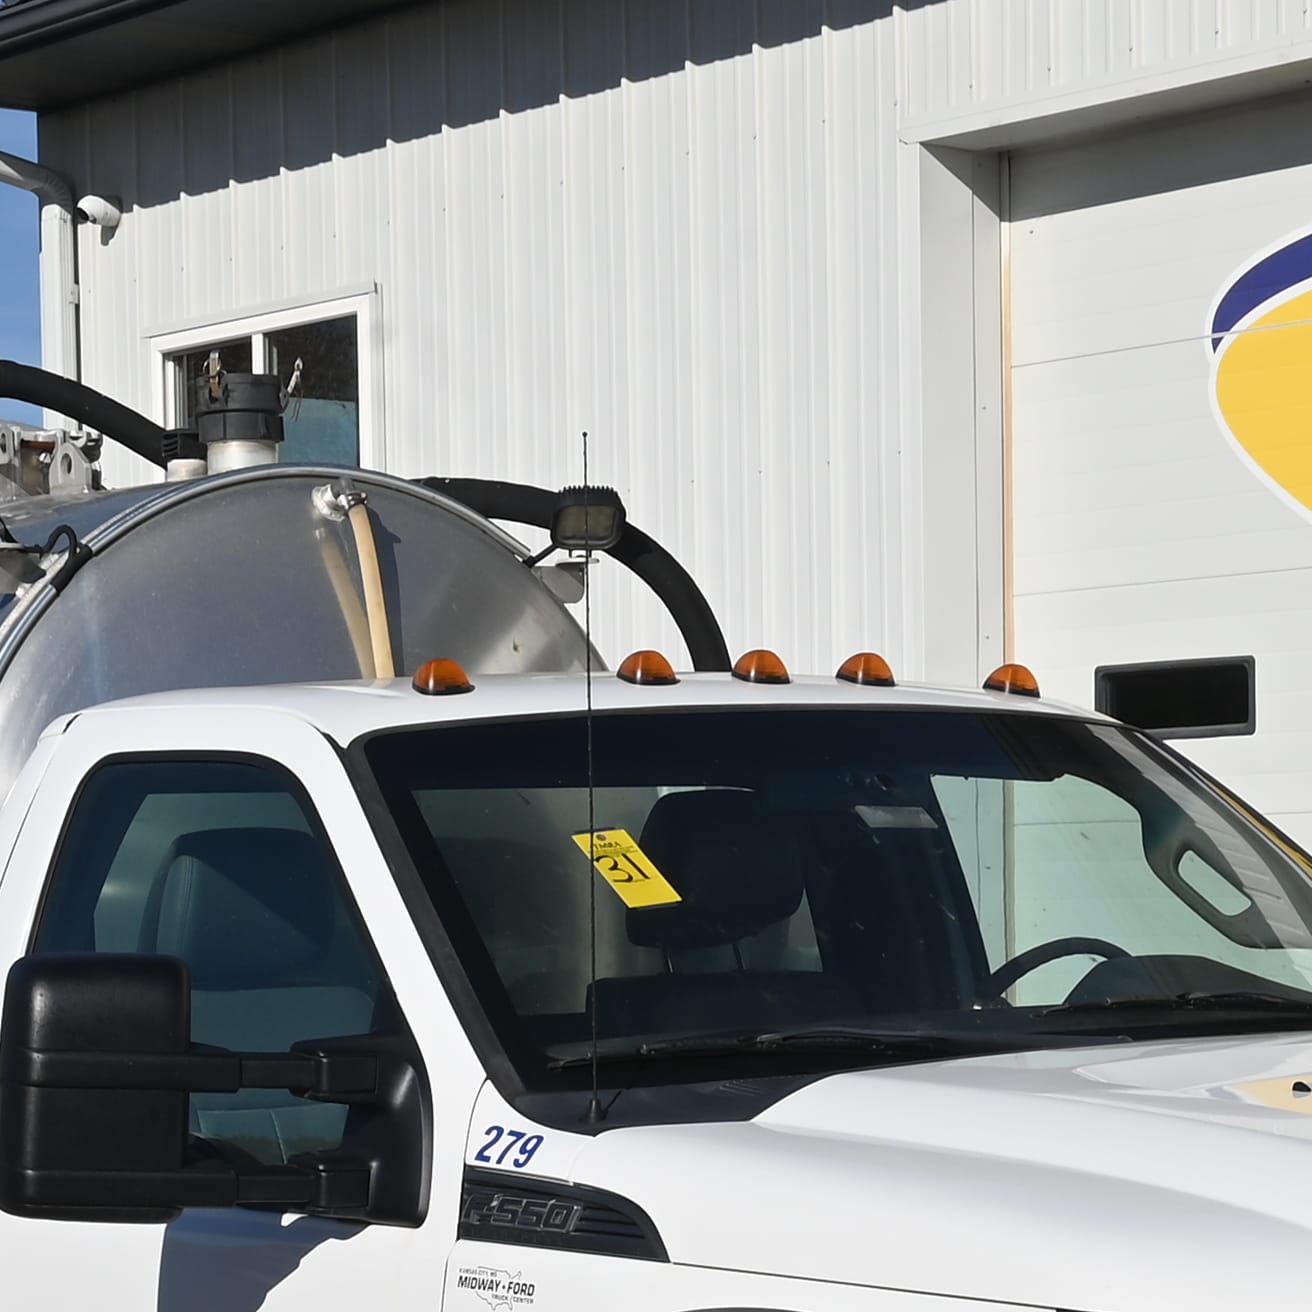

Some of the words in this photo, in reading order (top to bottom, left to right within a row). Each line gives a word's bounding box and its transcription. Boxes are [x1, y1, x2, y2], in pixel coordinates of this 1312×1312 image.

[594, 852, 651, 883] 31
[474, 1125, 544, 1168] 279
[457, 1275, 502, 1292] MIDWAY
[507, 1281, 535, 1297] FORD
